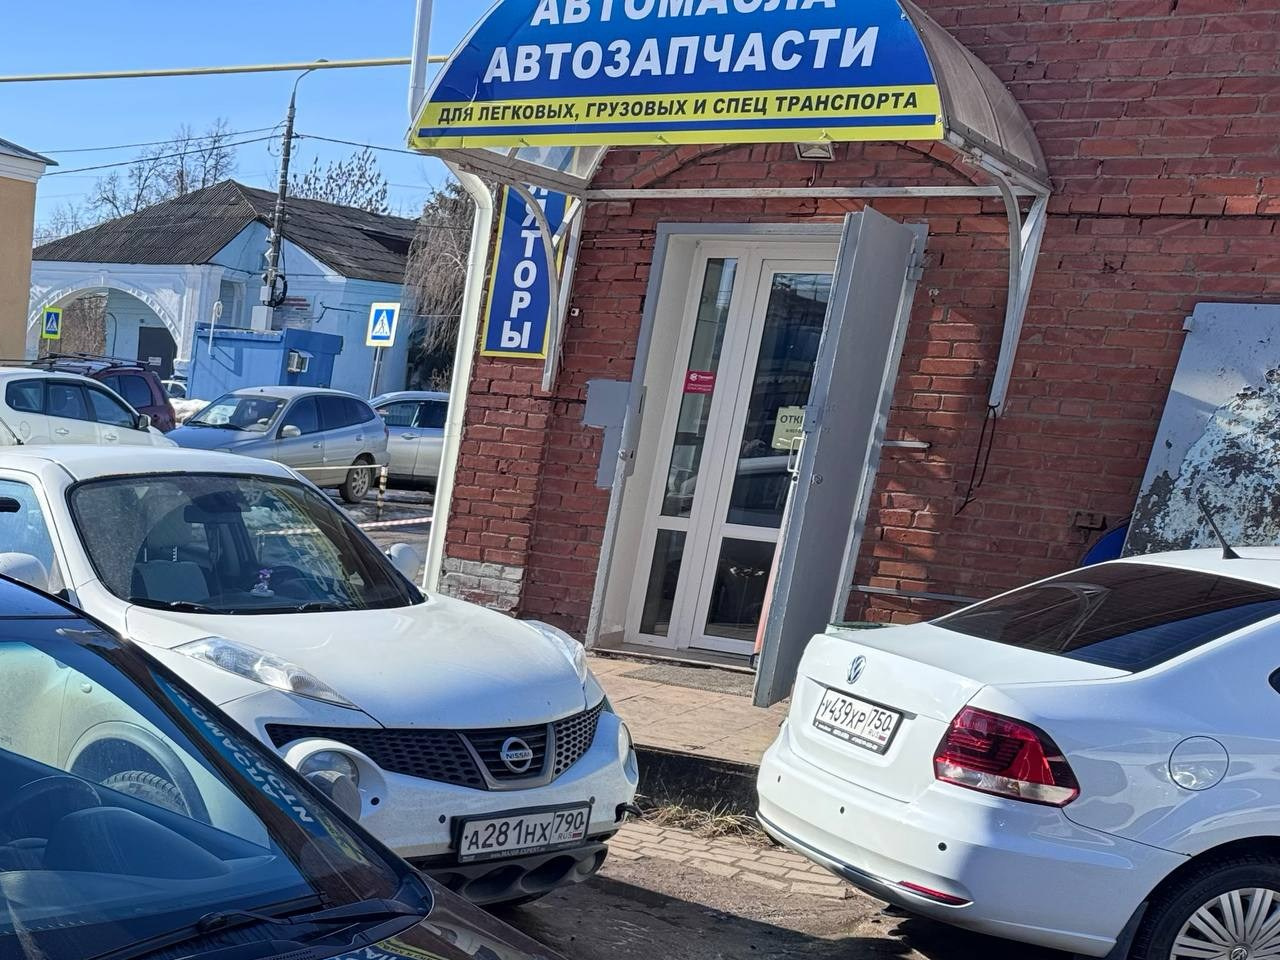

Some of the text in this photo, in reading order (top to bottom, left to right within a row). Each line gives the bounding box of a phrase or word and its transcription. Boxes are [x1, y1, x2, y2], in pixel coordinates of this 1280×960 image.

[530, 0, 837, 26] АВТОМ
[482, 26, 879, 83] АВТОЗАПЧАСТИ
[438, 92, 918, 124] ДЛЯ ЛЕГКОВЫХ, ГРУЗОВЫХ И СПЕЦ ТРАНСПОРТА
[500, 183, 549, 349] ЯТОРЫ
[505, 751, 532, 760] NISSAN
